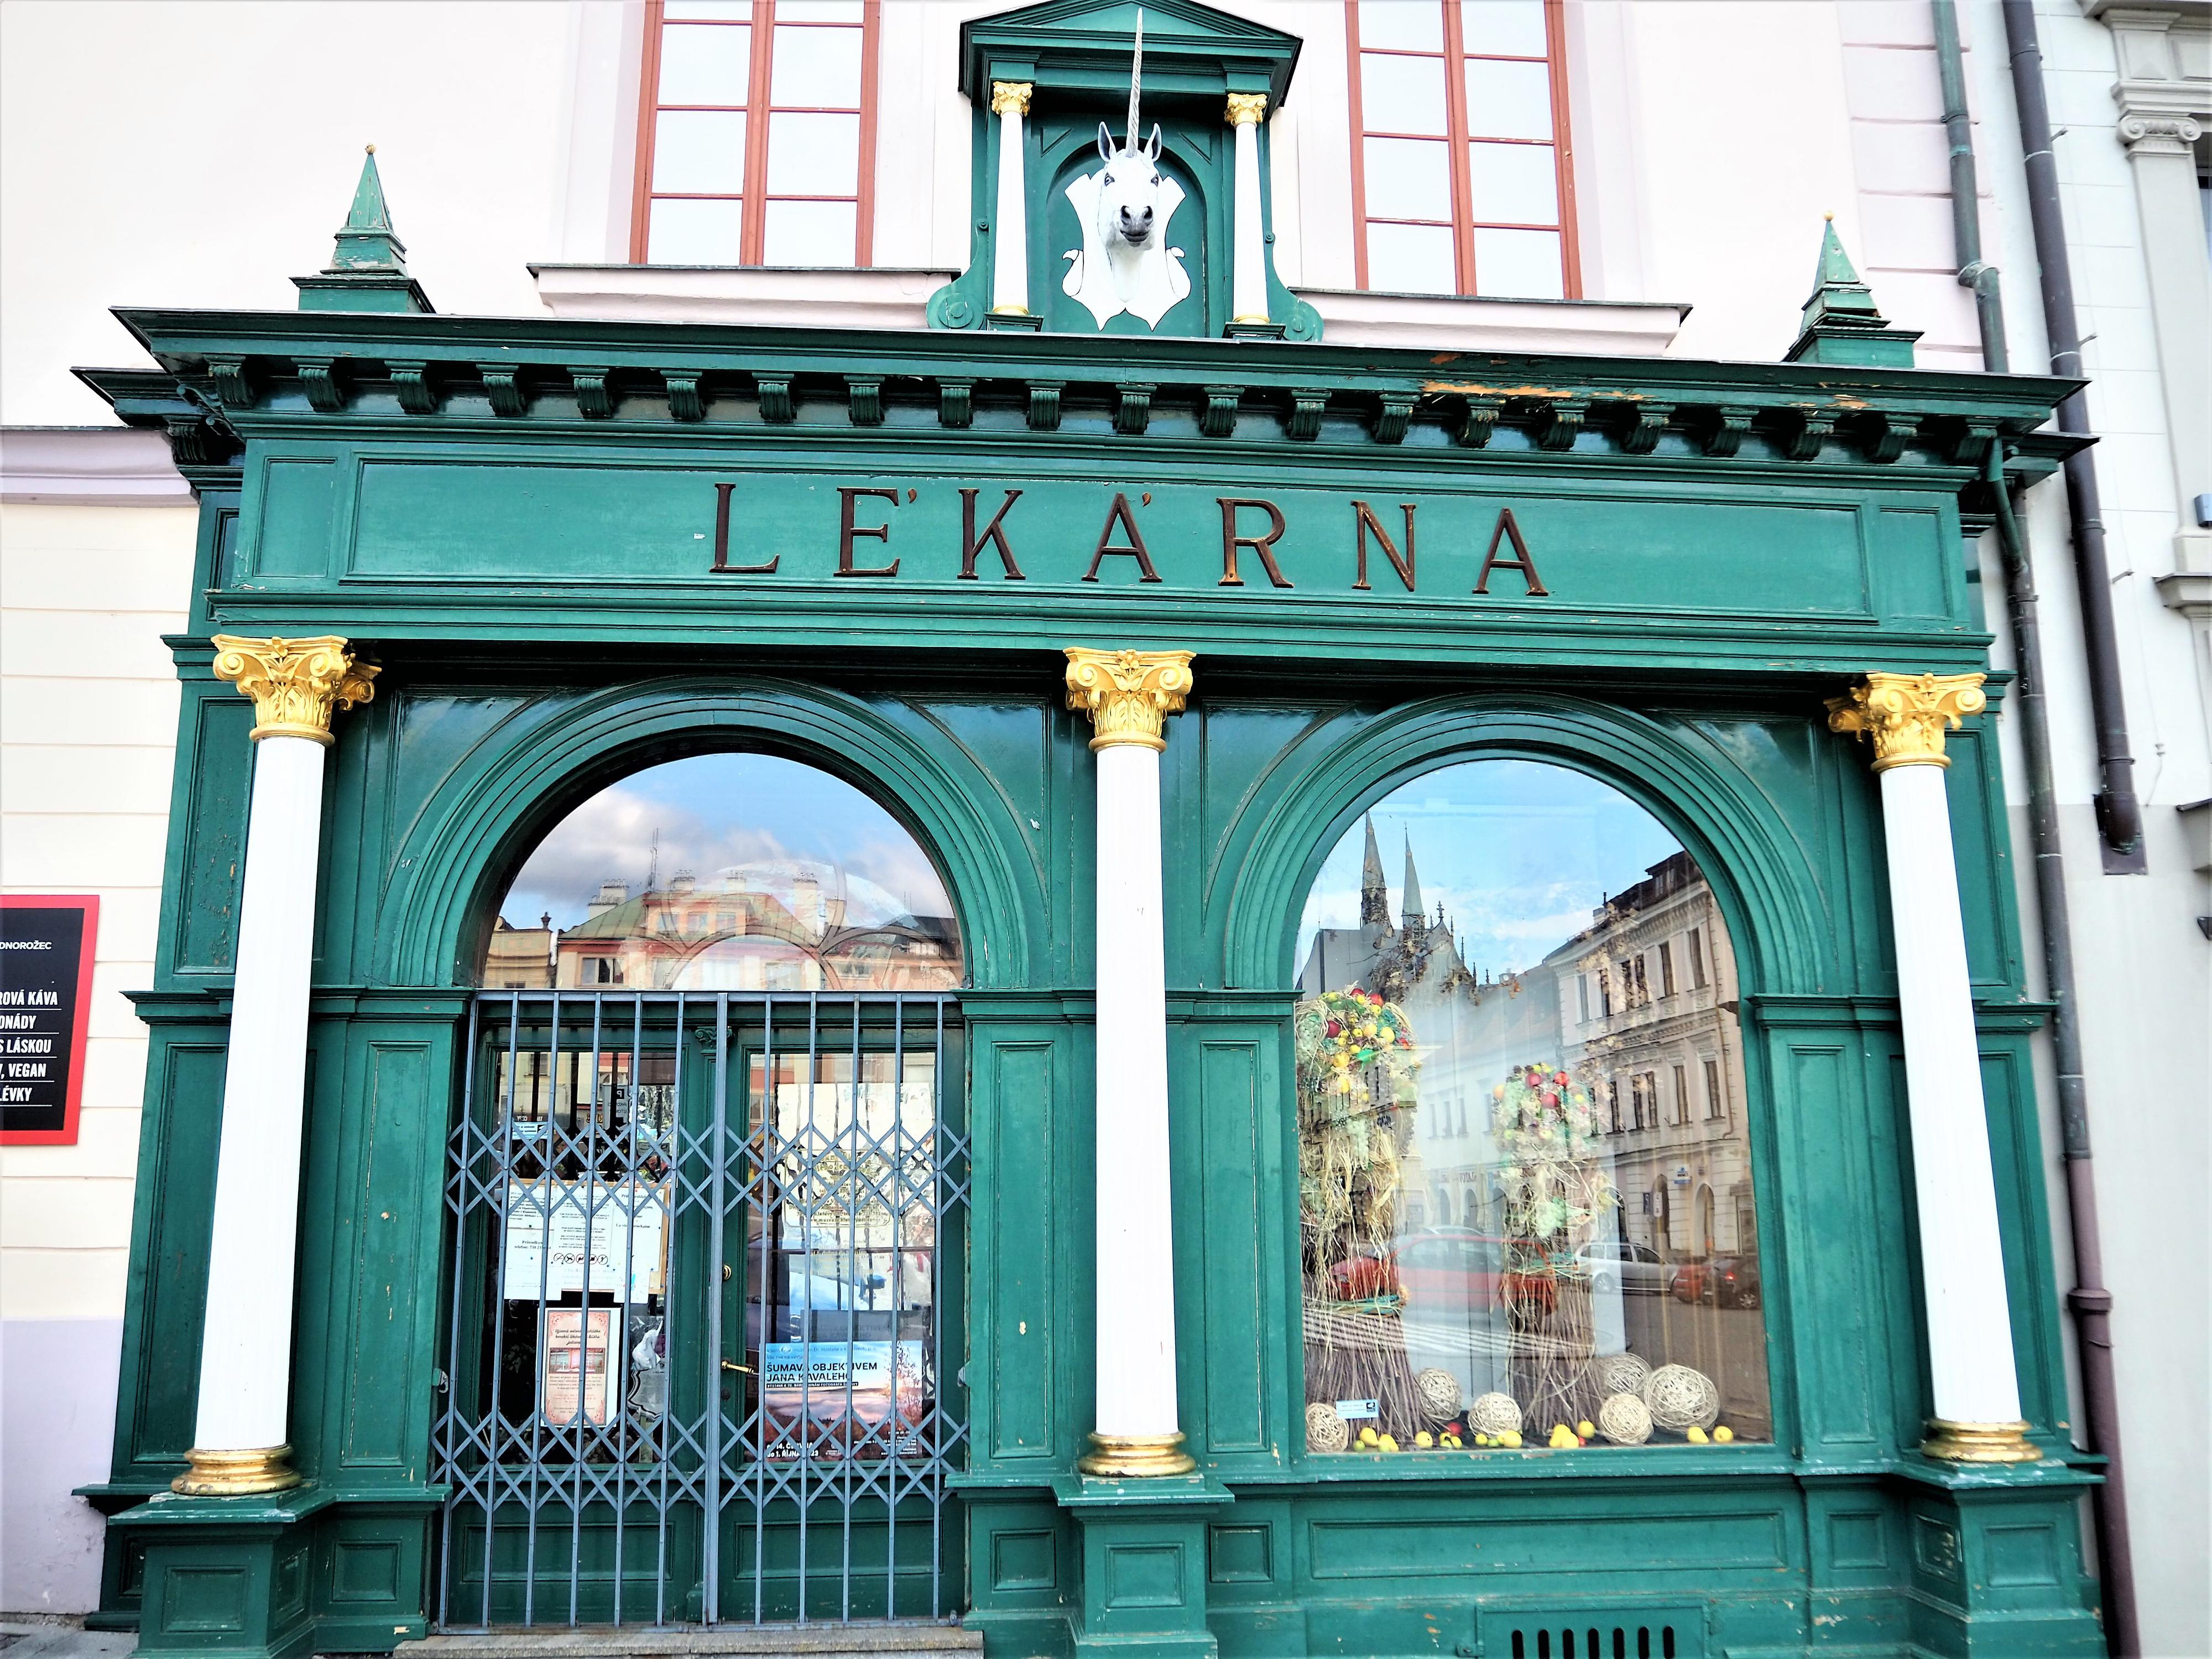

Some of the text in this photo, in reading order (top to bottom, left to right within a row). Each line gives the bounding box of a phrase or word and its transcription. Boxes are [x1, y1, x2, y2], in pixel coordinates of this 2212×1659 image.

[28, 989, 58, 1005] KÁVA
[0, 1013, 36, 1029] ONÁDY
[7, 1037, 52, 1053] LÁSKOU
[8, 1063, 46, 1077] VEGAN
[0, 1085, 33, 1102] ÉVKY
[767, 1362, 877, 1372] ŠUMAV OBJEKIVEM
